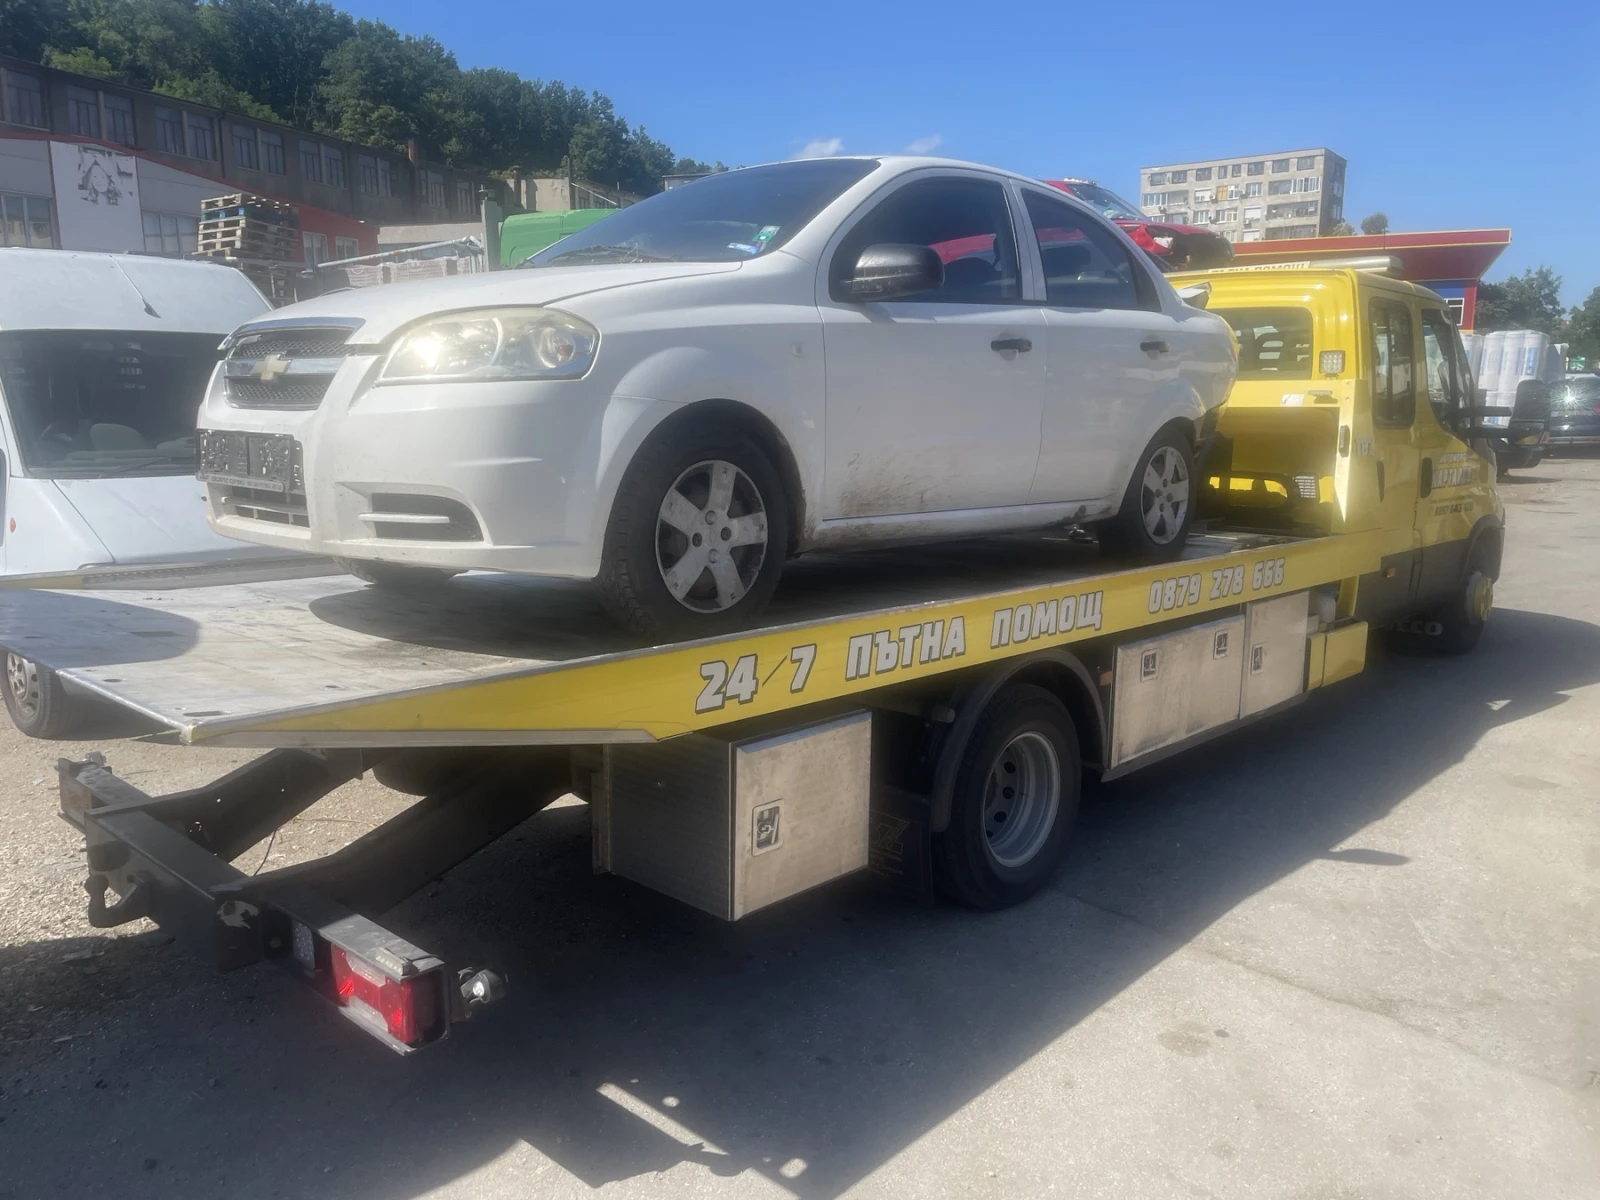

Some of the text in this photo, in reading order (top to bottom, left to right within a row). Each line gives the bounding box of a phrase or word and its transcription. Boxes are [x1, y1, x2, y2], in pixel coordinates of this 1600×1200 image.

[695, 557, 1285, 713] 24/7 ПЪТНА ПОМОЩ 0879 278 666
